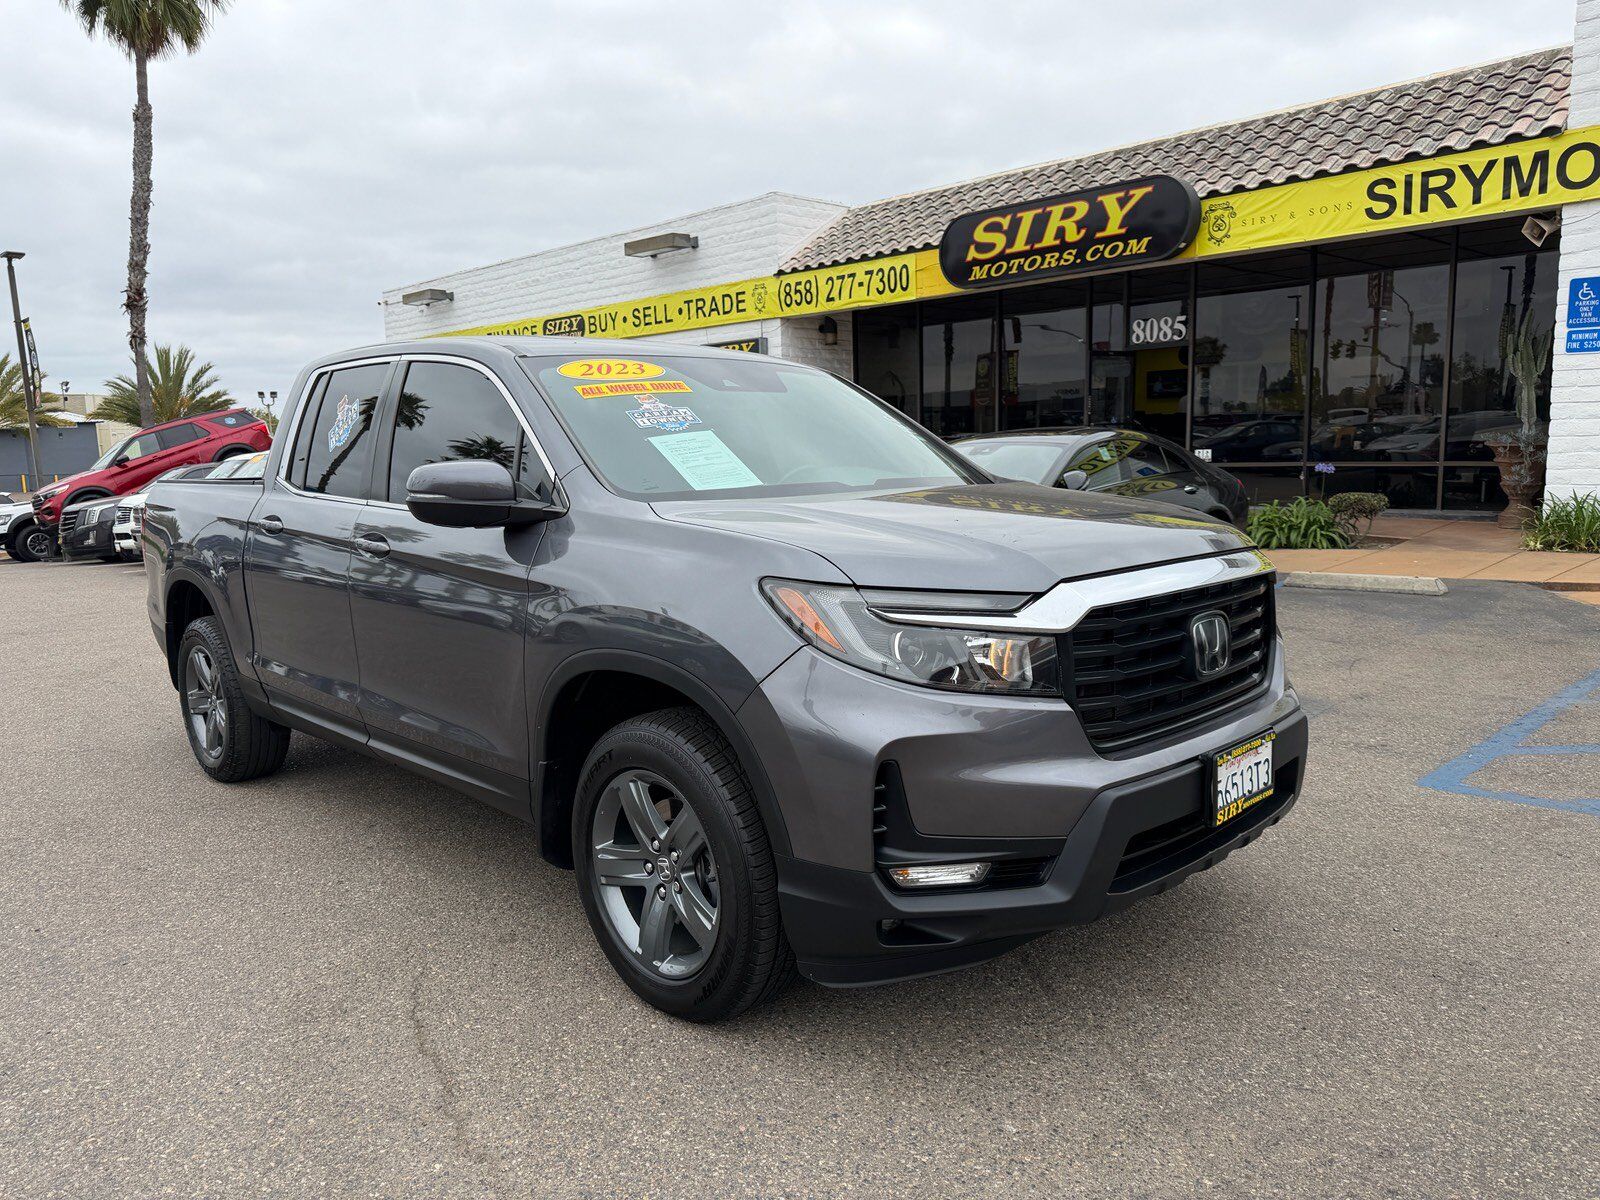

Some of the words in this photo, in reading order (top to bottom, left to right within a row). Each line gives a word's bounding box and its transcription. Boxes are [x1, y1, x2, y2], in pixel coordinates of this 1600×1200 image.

[1364, 141, 1600, 221] SIRYMO
[965, 184, 1155, 263] SIRY
[1241, 213, 1278, 227] SIRY
[1289, 210, 1297, 220] &
[1308, 201, 1354, 217] SONS
[967, 236, 1152, 282] MOTORS.COM
[778, 274, 819, 312] (858)
[825, 263, 910, 303] 277-7300
[545, 316, 582, 335] SIRY
[588, 311, 618, 335] BUY
[632, 303, 673, 328] SELL
[684, 290, 747, 321] TRADE
[1132, 315, 1187, 344] 8085
[1572, 332, 1598, 340] MINIMUM
[1567, 341, 1581, 349] FINE
[1583, 340, 1600, 349] $250
[579, 362, 645, 377] 2023
[581, 386, 605, 397] ALL
[606, 382, 649, 394] WHEEL
[650, 381, 688, 392] DRIVE
[632, 407, 693, 419] CARFAX
[1216, 797, 1246, 827] SIRY
